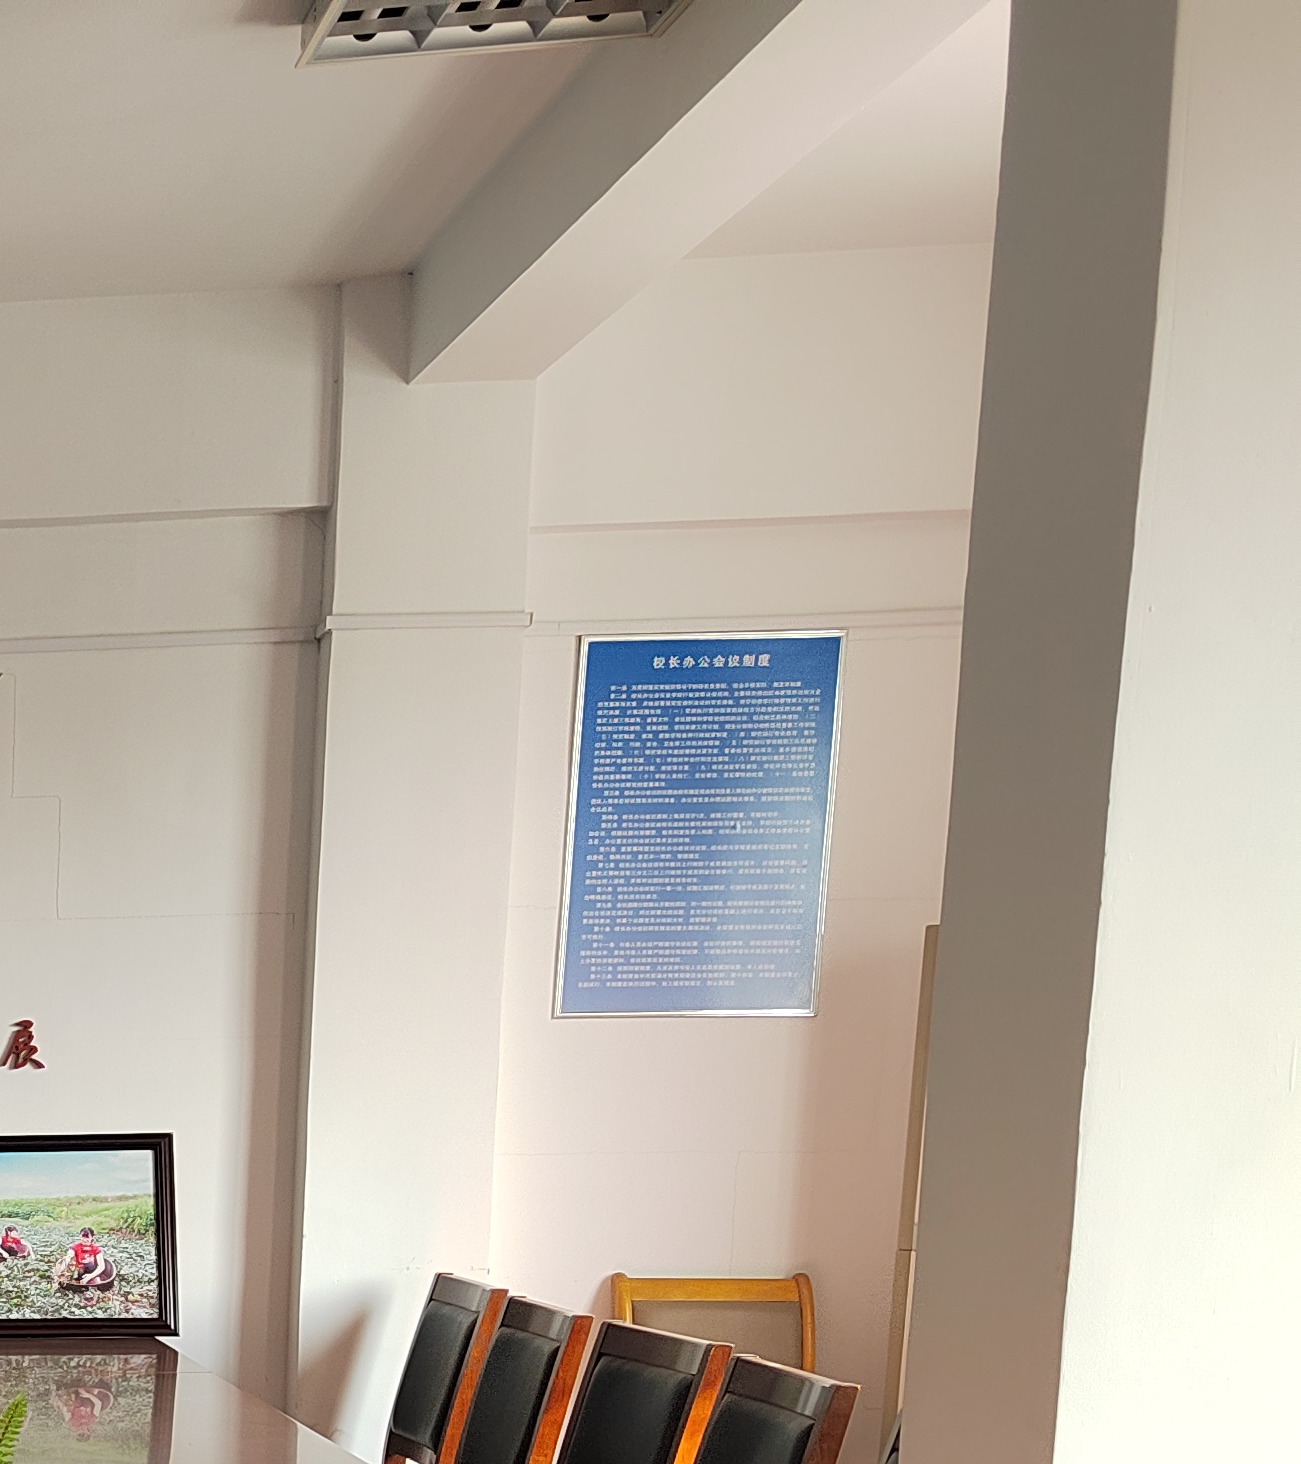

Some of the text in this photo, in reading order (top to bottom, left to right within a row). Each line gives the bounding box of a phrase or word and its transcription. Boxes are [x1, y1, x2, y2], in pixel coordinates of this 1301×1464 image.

[652, 654, 771, 669] 校长办公会议制度
